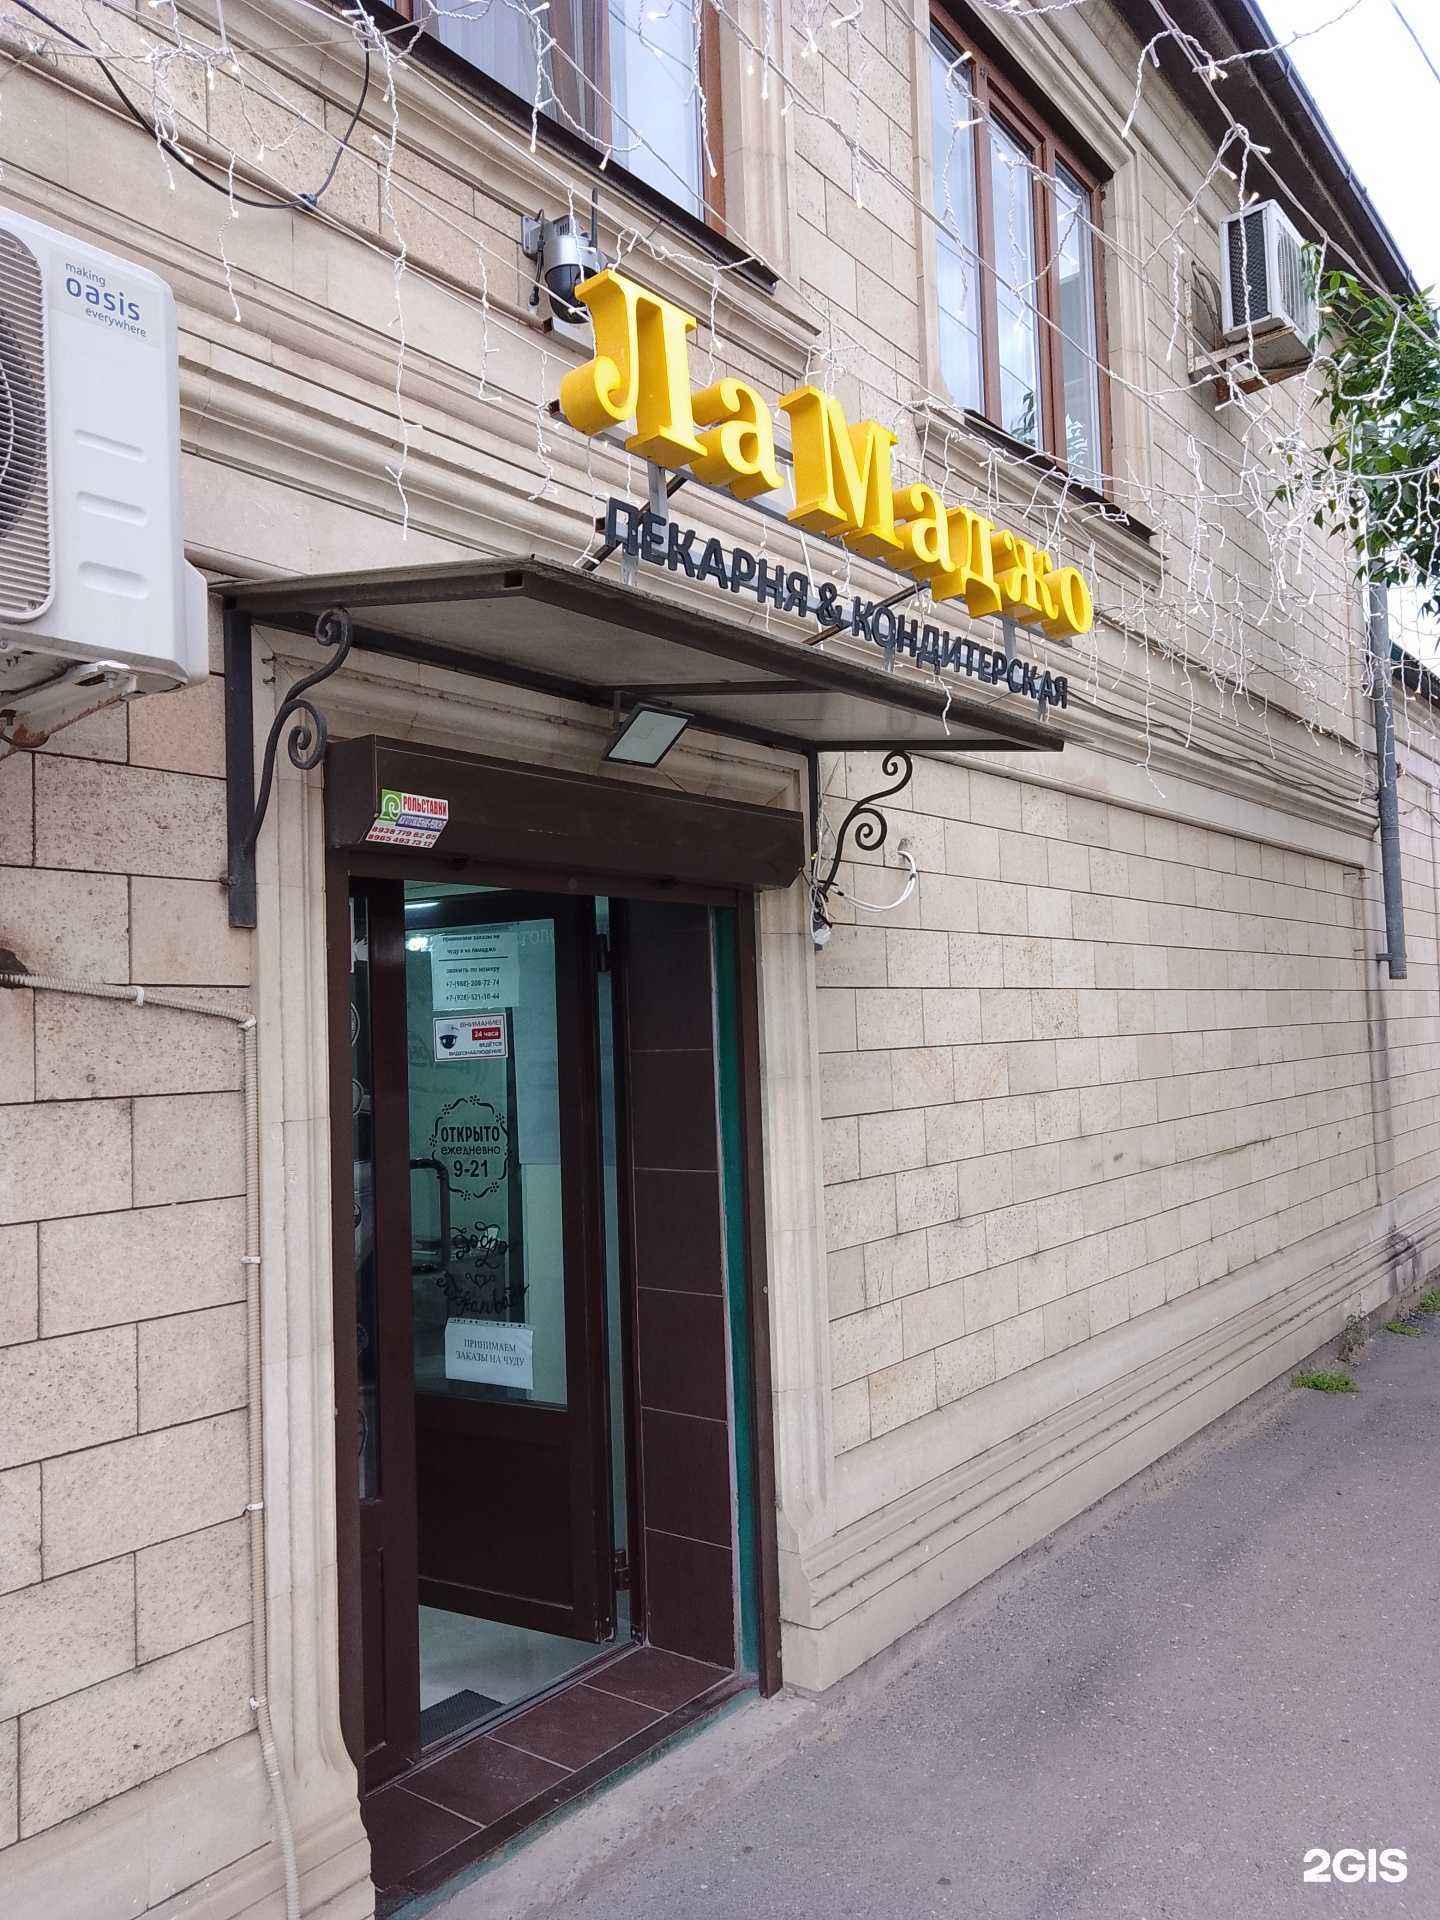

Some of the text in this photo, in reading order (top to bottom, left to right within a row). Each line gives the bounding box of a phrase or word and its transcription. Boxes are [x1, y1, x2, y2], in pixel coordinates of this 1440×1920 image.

[65, 262, 106, 287] making
[66, 278, 140, 321] oasis
[85, 307, 147, 337] everywhere
[605, 497, 1068, 709] ПЕКАРНЯ & КОНДИТЕРСКАЯ
[402, 795, 447, 817] РОЛЬСТАВНИ
[441, 1126, 500, 1143] ОТКРЫТО
[441, 1145, 501, 1155] ежедневно
[453, 1160, 488, 1178] 9-21
[464, 1338, 516, 1354] ПРИНИМАЕМ
[455, 1350, 526, 1368] ЗАКАЗЫ НА ЧУДУ
